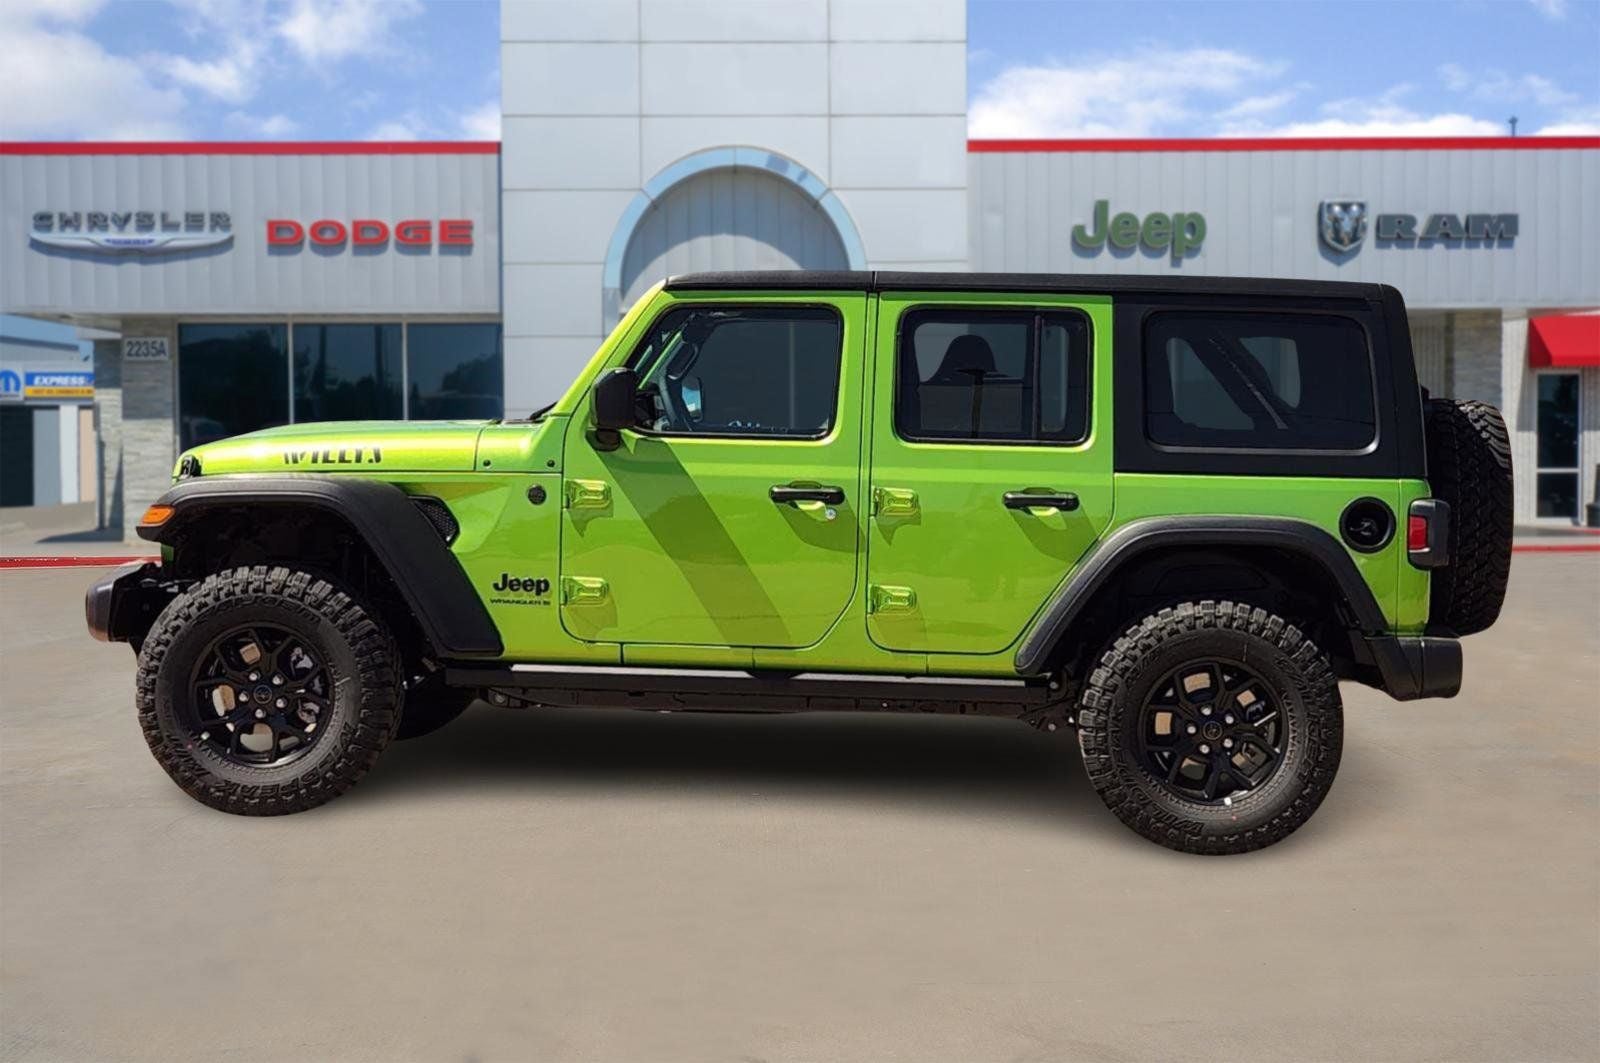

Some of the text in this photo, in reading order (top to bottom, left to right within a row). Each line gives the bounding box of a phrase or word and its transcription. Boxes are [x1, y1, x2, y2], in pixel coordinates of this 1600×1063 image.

[32, 211, 231, 231] CHRYSLER
[266, 219, 474, 246] DODGE
[1071, 199, 1206, 256] Jeep
[1377, 213, 1519, 240] RAM
[126, 341, 167, 358] 2235A
[33, 375, 86, 386] EXPRESS
[493, 573, 550, 596] Jeep
